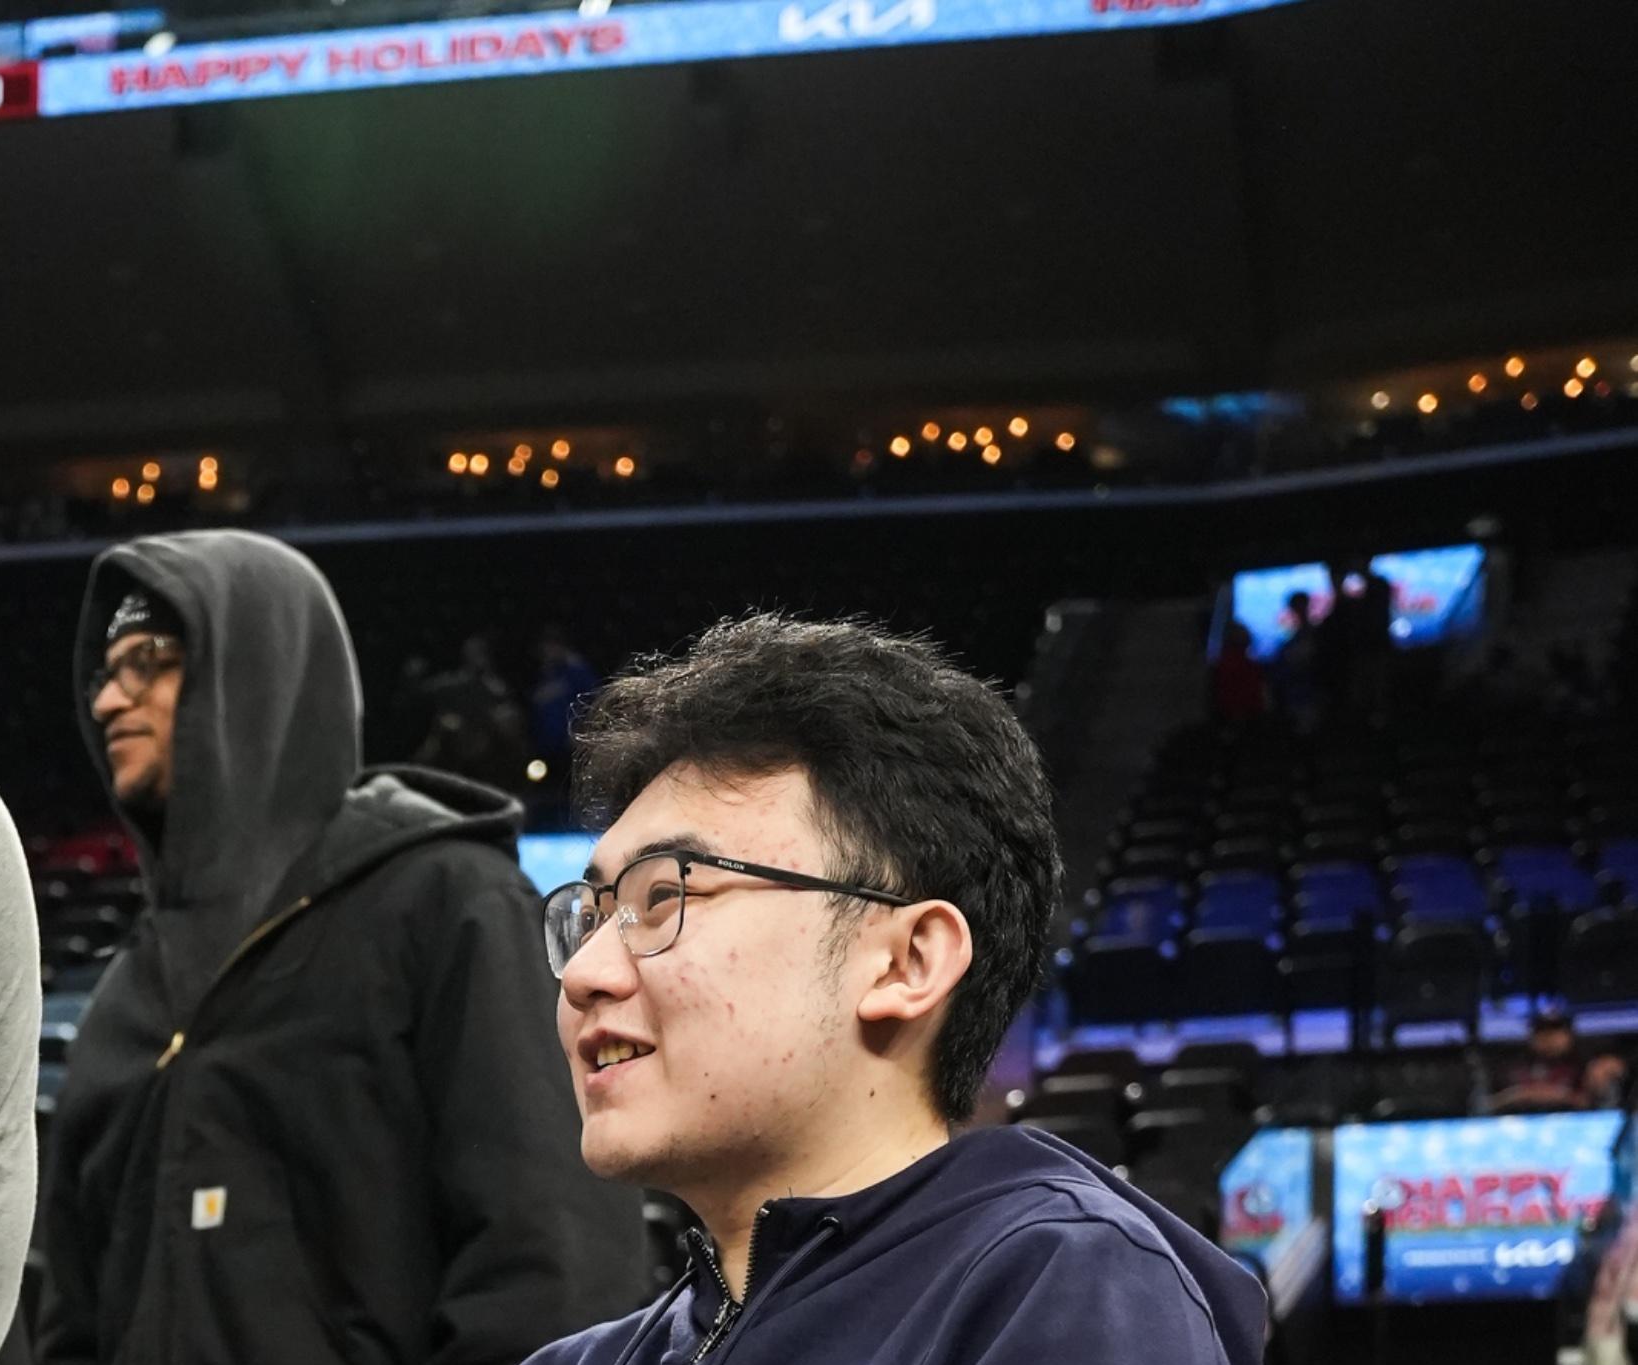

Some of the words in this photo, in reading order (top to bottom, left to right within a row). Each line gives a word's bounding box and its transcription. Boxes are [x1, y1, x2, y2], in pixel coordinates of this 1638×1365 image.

[110, 54, 306, 97] HAPPY
[328, 22, 626, 75] HOLIDAYS
[717, 858, 746, 871] BOLON
